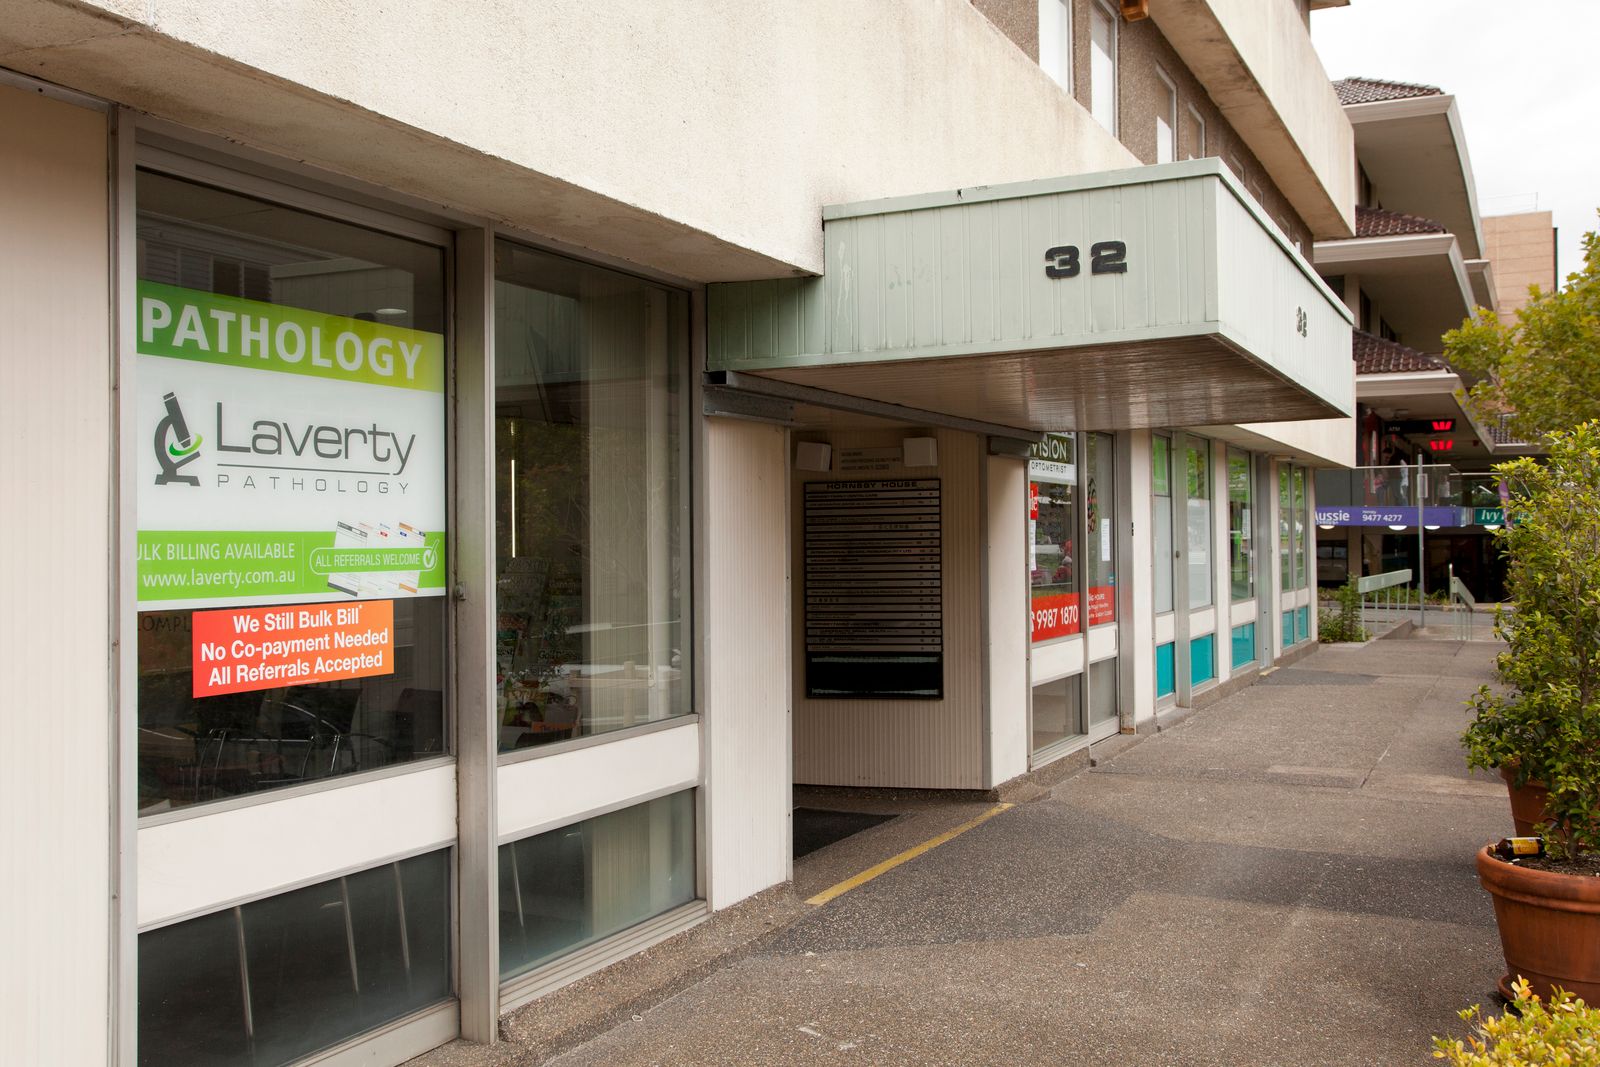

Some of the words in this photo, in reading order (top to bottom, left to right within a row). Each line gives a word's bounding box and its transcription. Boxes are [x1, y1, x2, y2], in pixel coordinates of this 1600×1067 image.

[1045, 240, 1128, 279] 32
[141, 297, 423, 380] PATHOLOGY
[216, 402, 416, 476] Laverty
[1031, 438, 1067, 460] VISION
[1031, 461, 1067, 474] OPTOMETRIST
[217, 474, 409, 494] PATHOLOGY
[881, 481, 918, 489] HOUSE
[1362, 514, 1382, 522] 9477
[1382, 514, 1402, 522] 4277
[1481, 509, 1500, 522] Ivy
[137, 543, 162, 561] ULK
[166, 543, 221, 561] BILLING
[224, 542, 296, 559] AVAILABLE
[315, 554, 332, 567] ALL
[334, 553, 381, 567] REFERRALS
[383, 552, 420, 565] WELCOME
[142, 567, 296, 589] www.laverty.com.au
[138, 615, 191, 633] OMPL
[232, 615, 260, 634] We
[264, 612, 294, 632] Still
[299, 610, 333, 629] Bulk
[1036, 608, 1058, 630] 9987
[1060, 604, 1079, 625] 1870
[201, 642, 226, 662] No
[231, 633, 331, 660] Co-payment
[334, 628, 389, 649] Needed
[208, 665, 231, 687] All
[236, 659, 310, 684] Referrals
[313, 651, 384, 674] Accepted
